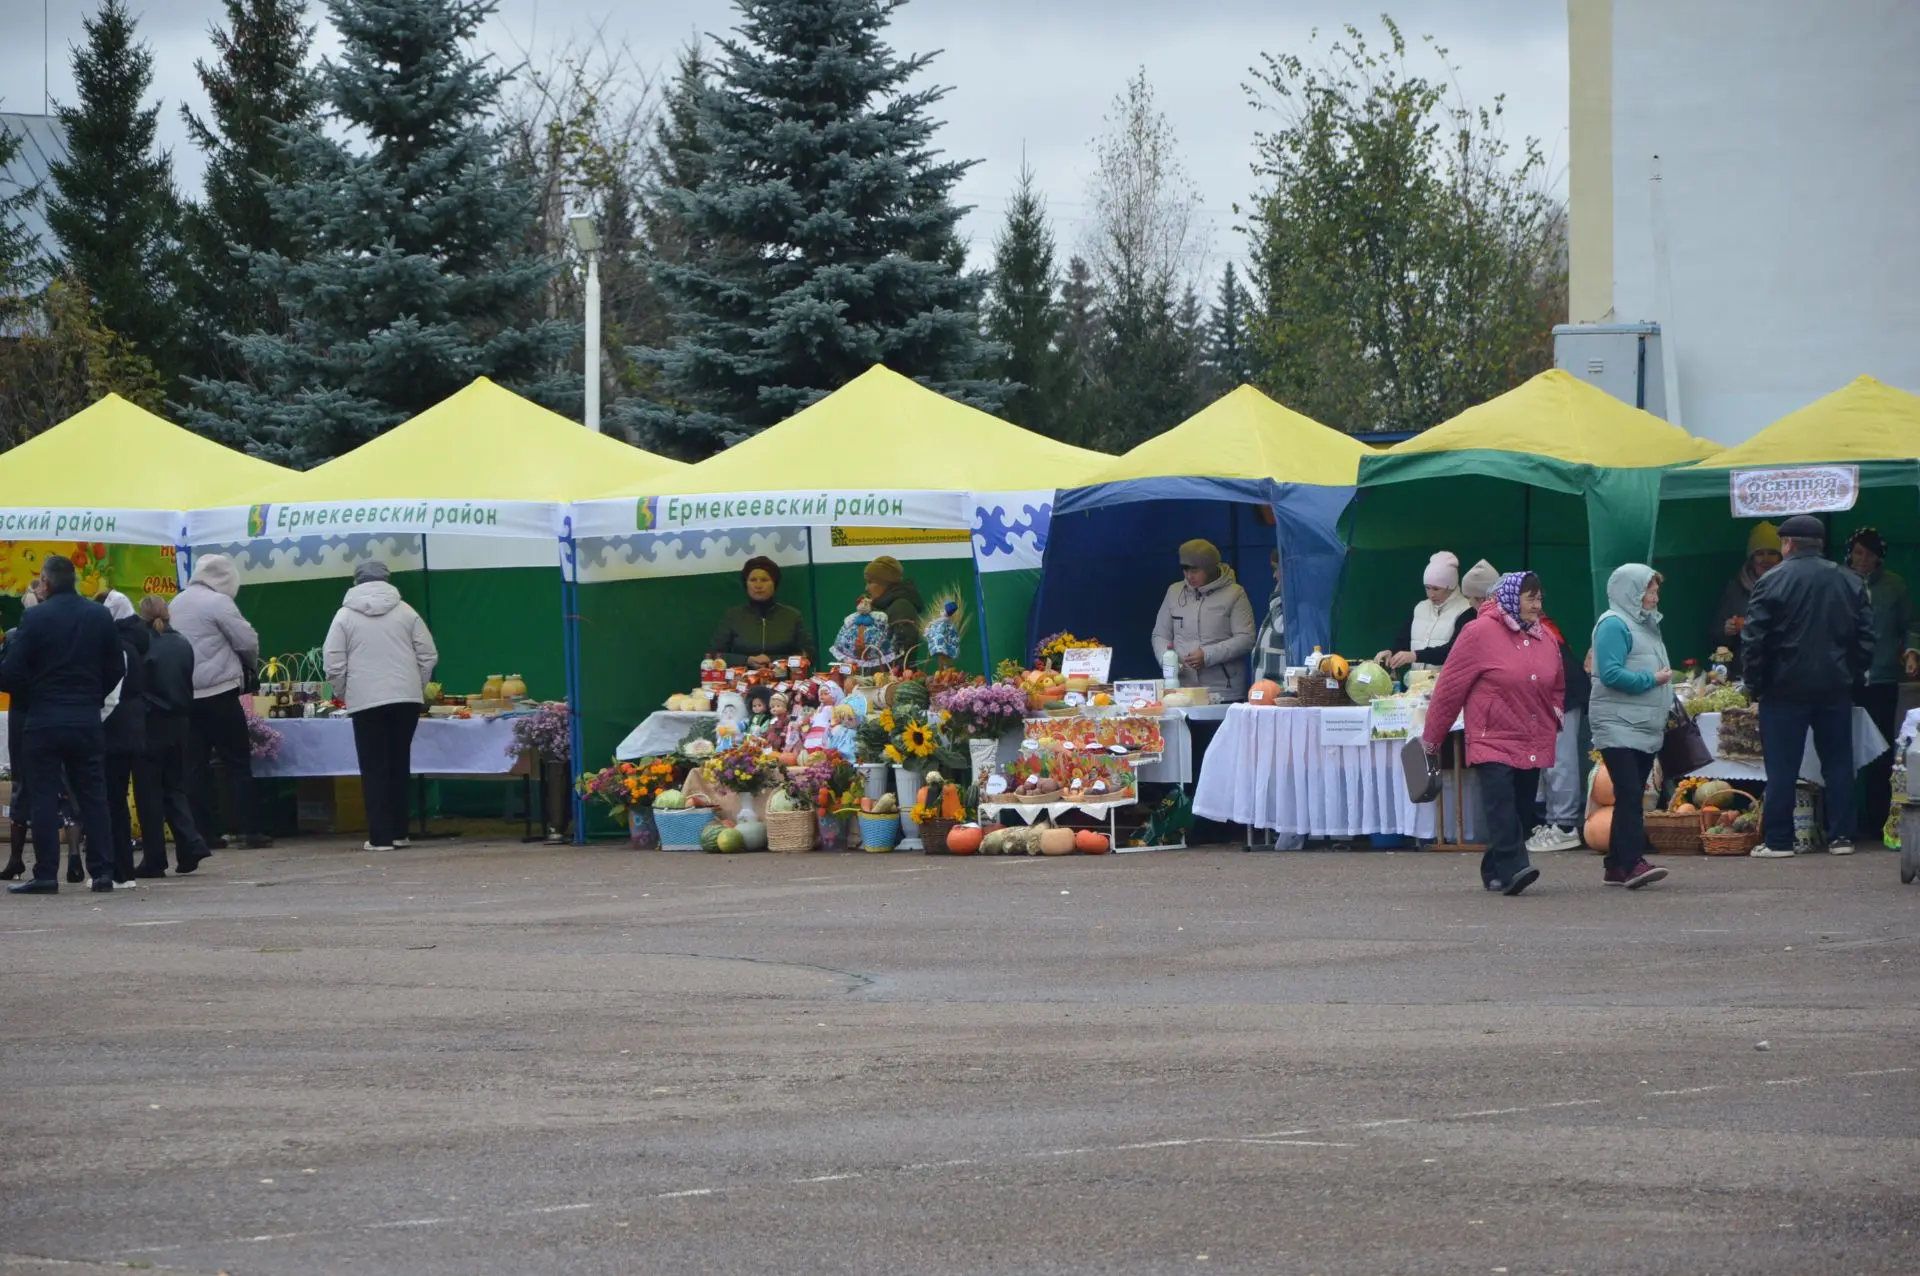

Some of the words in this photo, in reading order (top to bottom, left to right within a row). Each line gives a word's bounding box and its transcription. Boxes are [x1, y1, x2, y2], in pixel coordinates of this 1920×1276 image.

[1747, 477, 1837, 492] ОСЕННЯЯ
[1747, 488, 1836, 504] ЯРМАРКА
[277, 502, 427, 532] Ермекеевский
[431, 503, 497, 528] район
[667, 493, 828, 525] Ермекеевский
[833, 494, 903, 521] район
[55, 511, 117, 536] район
